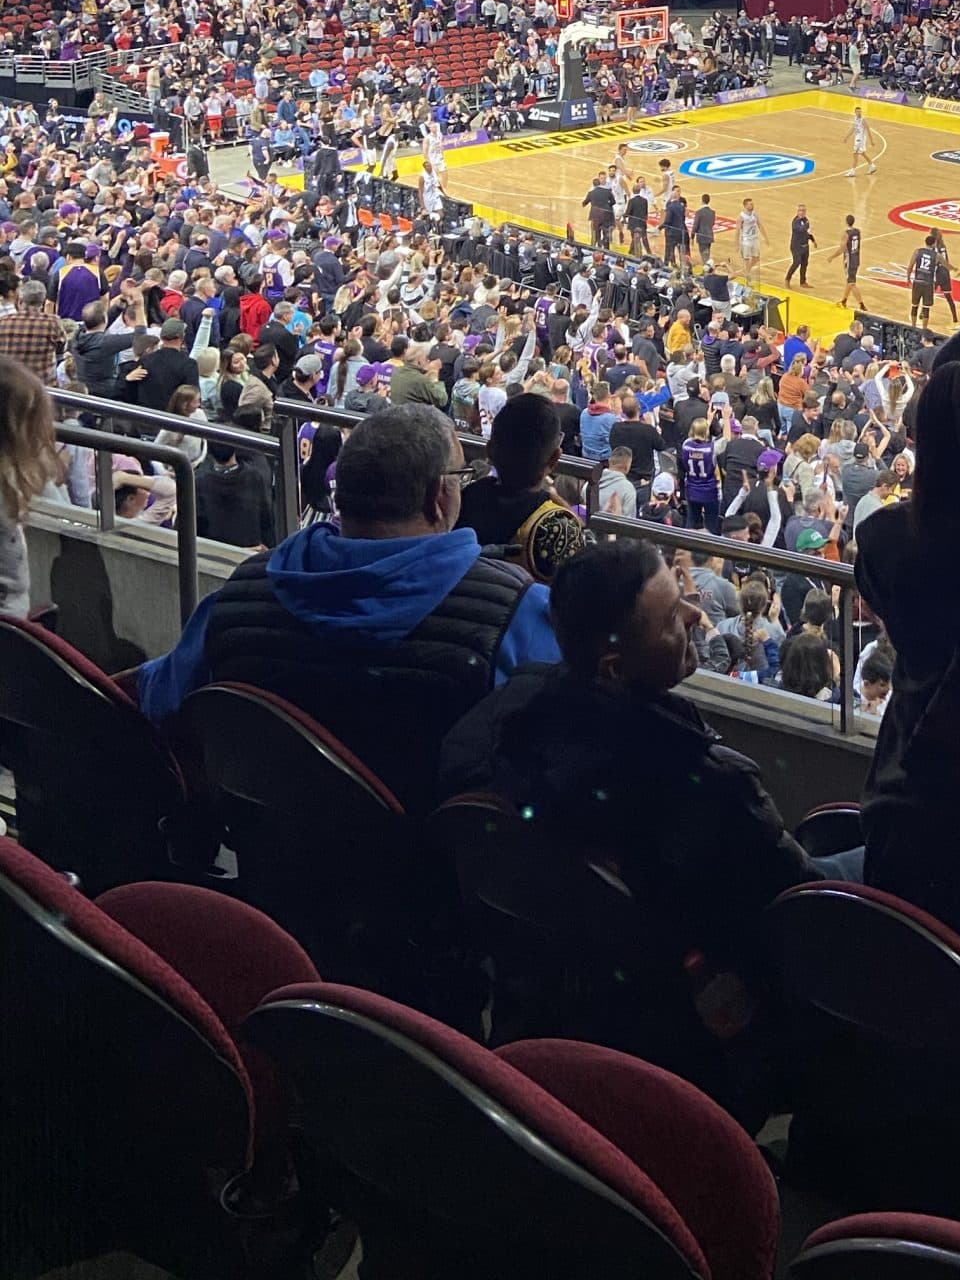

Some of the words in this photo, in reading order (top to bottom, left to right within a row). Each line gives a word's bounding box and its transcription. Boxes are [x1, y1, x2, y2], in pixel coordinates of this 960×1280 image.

[501, 133, 578, 152] RISE
[567, 123, 649, 141] WITH
[651, 116, 690, 128] US
[920, 257, 930, 270] 12
[688, 459, 707, 477] 11
